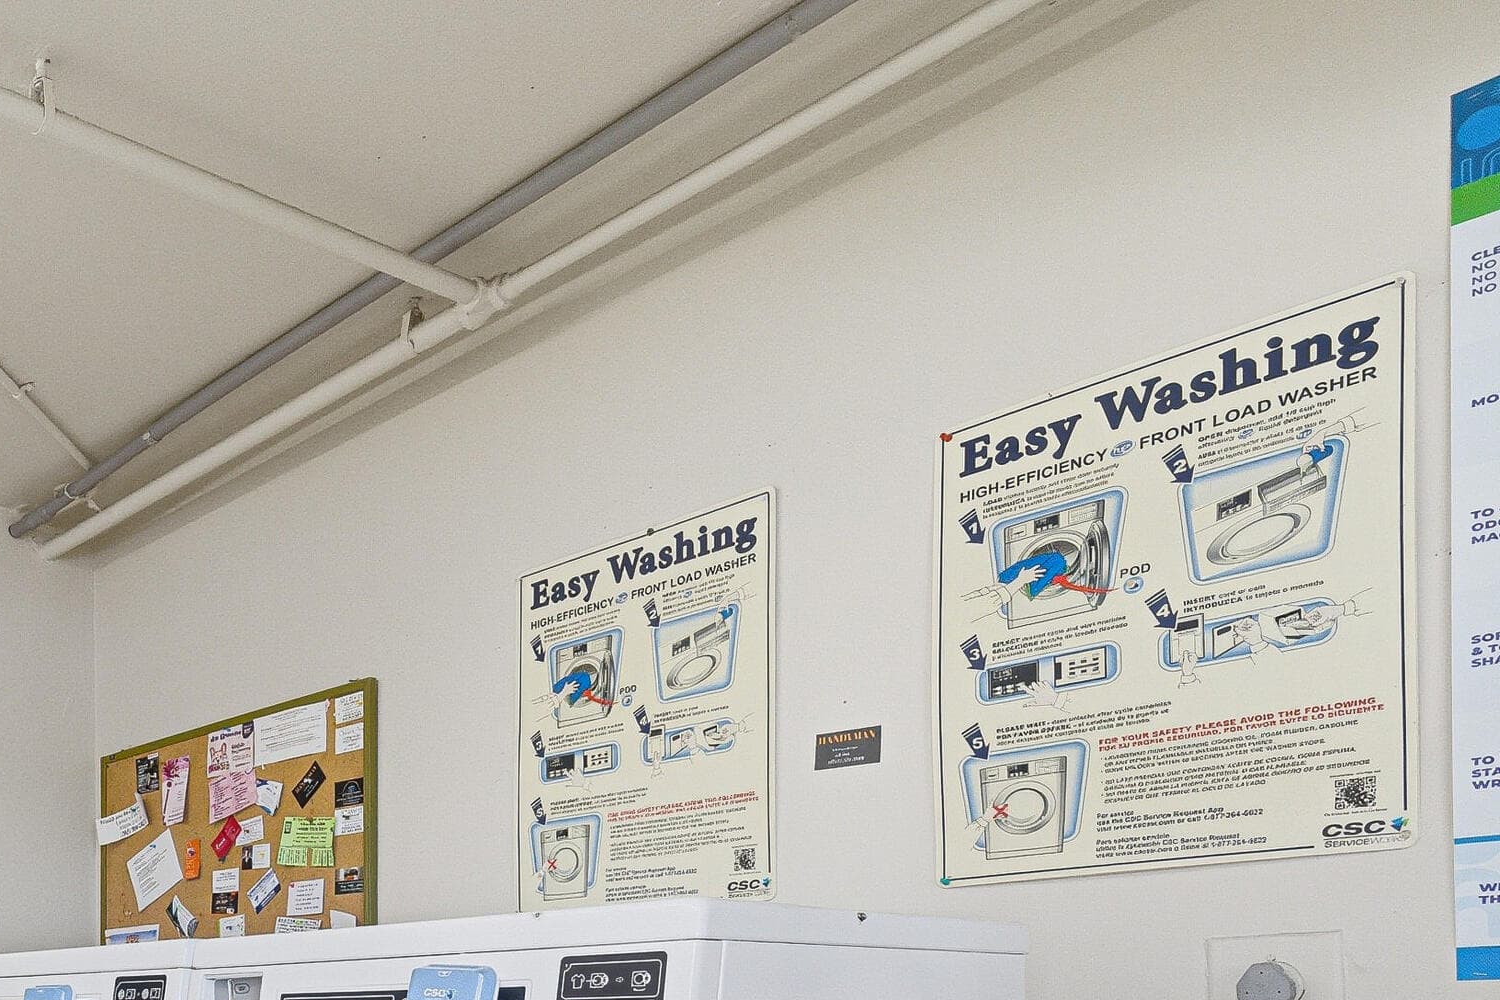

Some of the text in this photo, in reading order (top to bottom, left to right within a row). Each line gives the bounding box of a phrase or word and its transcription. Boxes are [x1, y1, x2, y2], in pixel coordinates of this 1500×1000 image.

[1472, 259, 1497, 273] NO
[1472, 271, 1497, 285] NO
[1472, 283, 1497, 297] NO
[959, 316, 1380, 477] Easy Washing
[1471, 394, 1499, 407] MO
[960, 449, 1107, 504] HIGH-EFFICIENCY
[1139, 418, 1204, 450] FRONT
[1213, 398, 1272, 428] LOAD
[1278, 366, 1378, 408] WASHER
[1172, 457, 1188, 475] 2
[1470, 508, 1495, 519] TO
[1471, 520, 1500, 531] OD
[1471, 532, 1500, 544] MA
[530, 569, 600, 611] Easy
[607, 516, 758, 587] Washing
[1120, 563, 1151, 579] POD
[530, 597, 614, 630] HIGH-EFFICIENCY
[631, 581, 668, 601] FRONT
[670, 570, 703, 590] LOAD
[705, 554, 757, 579] WASHER
[648, 608, 658, 621] 2
[1158, 603, 1171, 618] 4
[968, 648, 980, 662] 3
[1488, 644, 1500, 653] T
[1099, 697, 1375, 745] FOR YOUR SAFETY PLEASE AVOID THE FOLLOWING
[1471, 756, 1495, 766] TO
[1471, 767, 1500, 778] STA
[1472, 779, 1500, 790] WR
[1322, 820, 1386, 837] CSC
[727, 879, 760, 891] CSC
[1479, 883, 1500, 892] W
[1478, 894, 1500, 904] TH
